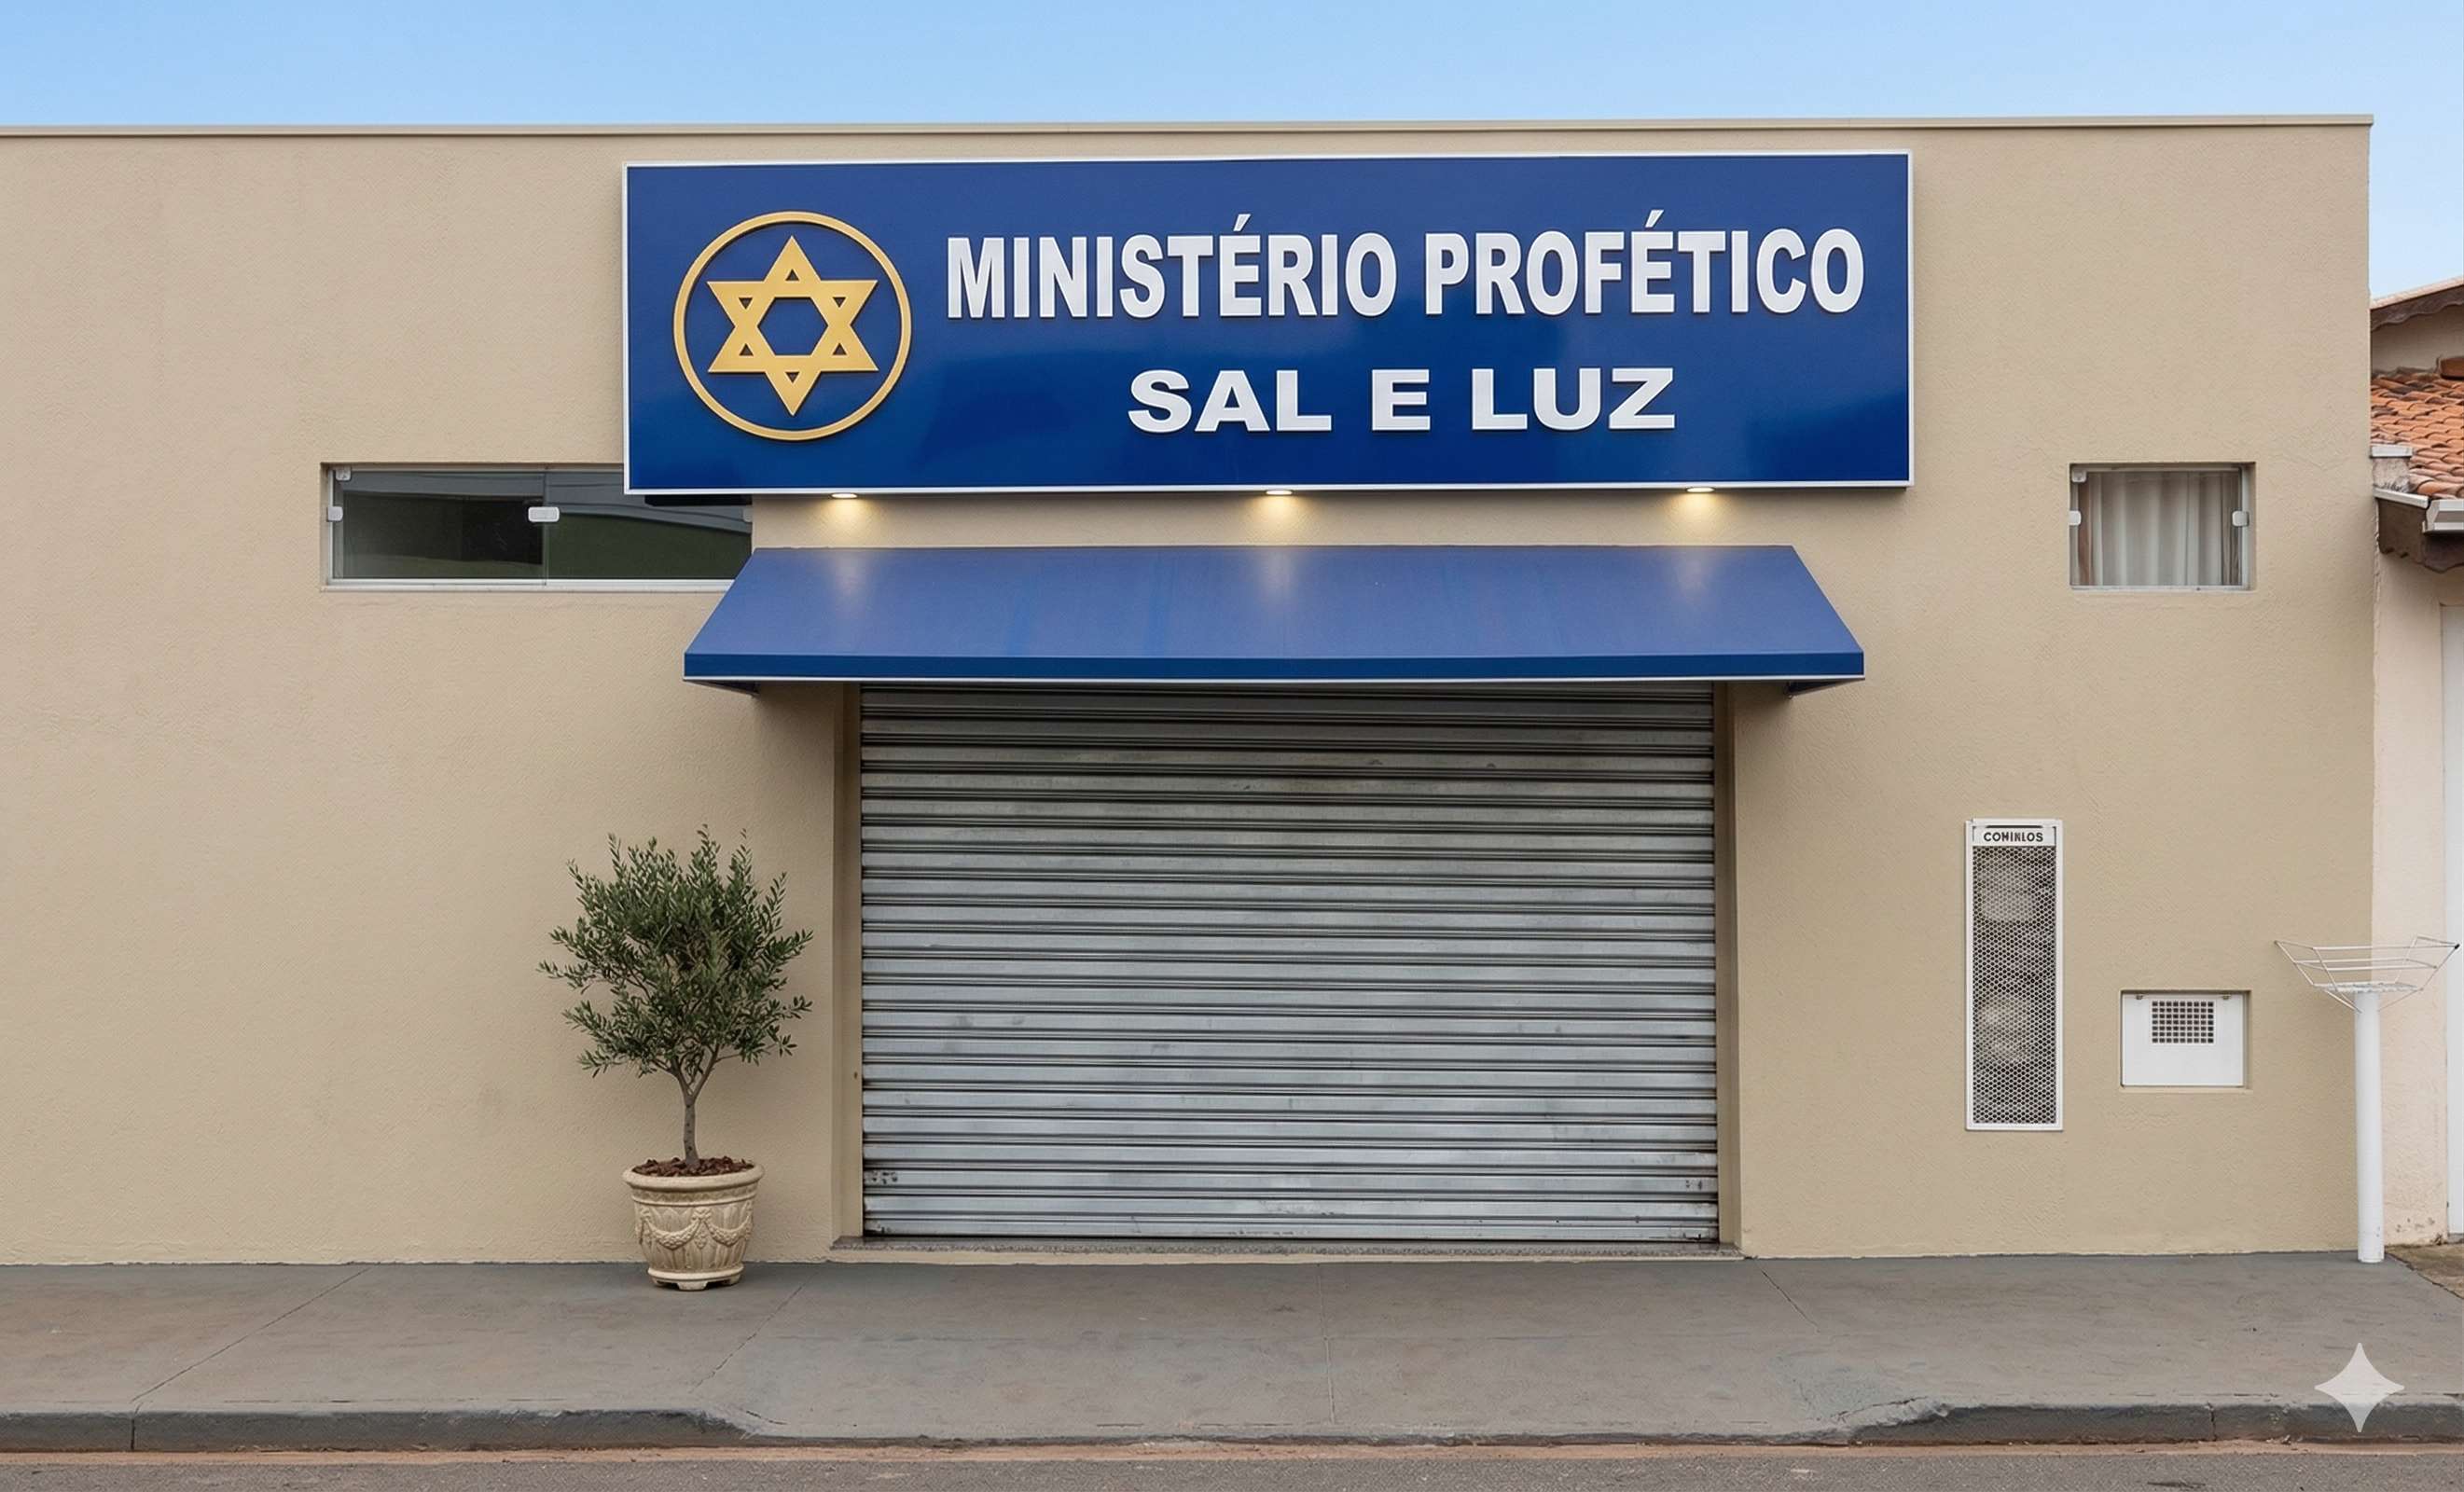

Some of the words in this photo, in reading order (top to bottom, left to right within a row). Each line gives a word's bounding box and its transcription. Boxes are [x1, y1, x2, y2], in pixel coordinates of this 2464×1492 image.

[948, 214, 1397, 318] MINISTÉRIO
[1425, 209, 1864, 315] PROFÉTICO
[1128, 369, 1332, 433] SAL
[1372, 368, 1431, 431] E
[1472, 367, 1675, 431] LUZ
